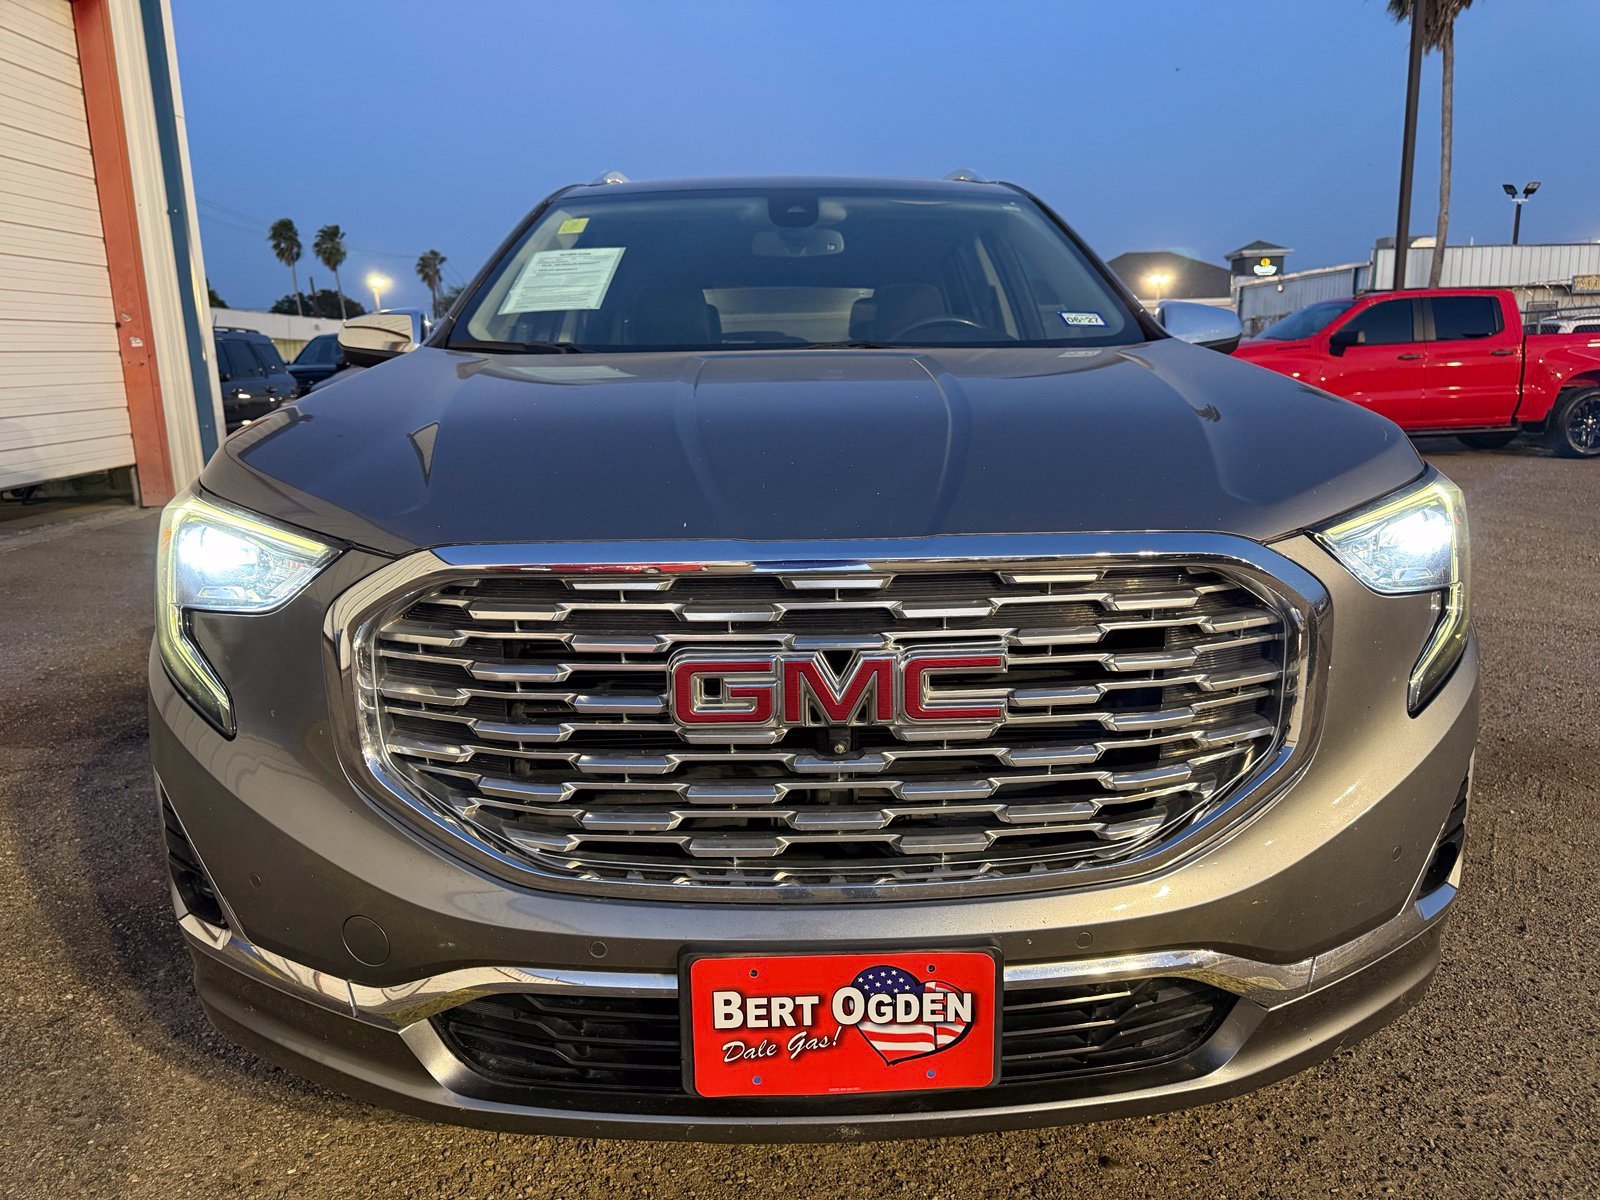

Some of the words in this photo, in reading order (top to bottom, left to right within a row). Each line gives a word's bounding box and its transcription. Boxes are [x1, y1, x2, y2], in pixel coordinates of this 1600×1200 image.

[669, 646, 1006, 727] GMC
[712, 990, 820, 1030] BERT
[831, 986, 973, 1026] OGDEN
[722, 1040, 778, 1063] Dale
[787, 1025, 842, 1060] Gas!
